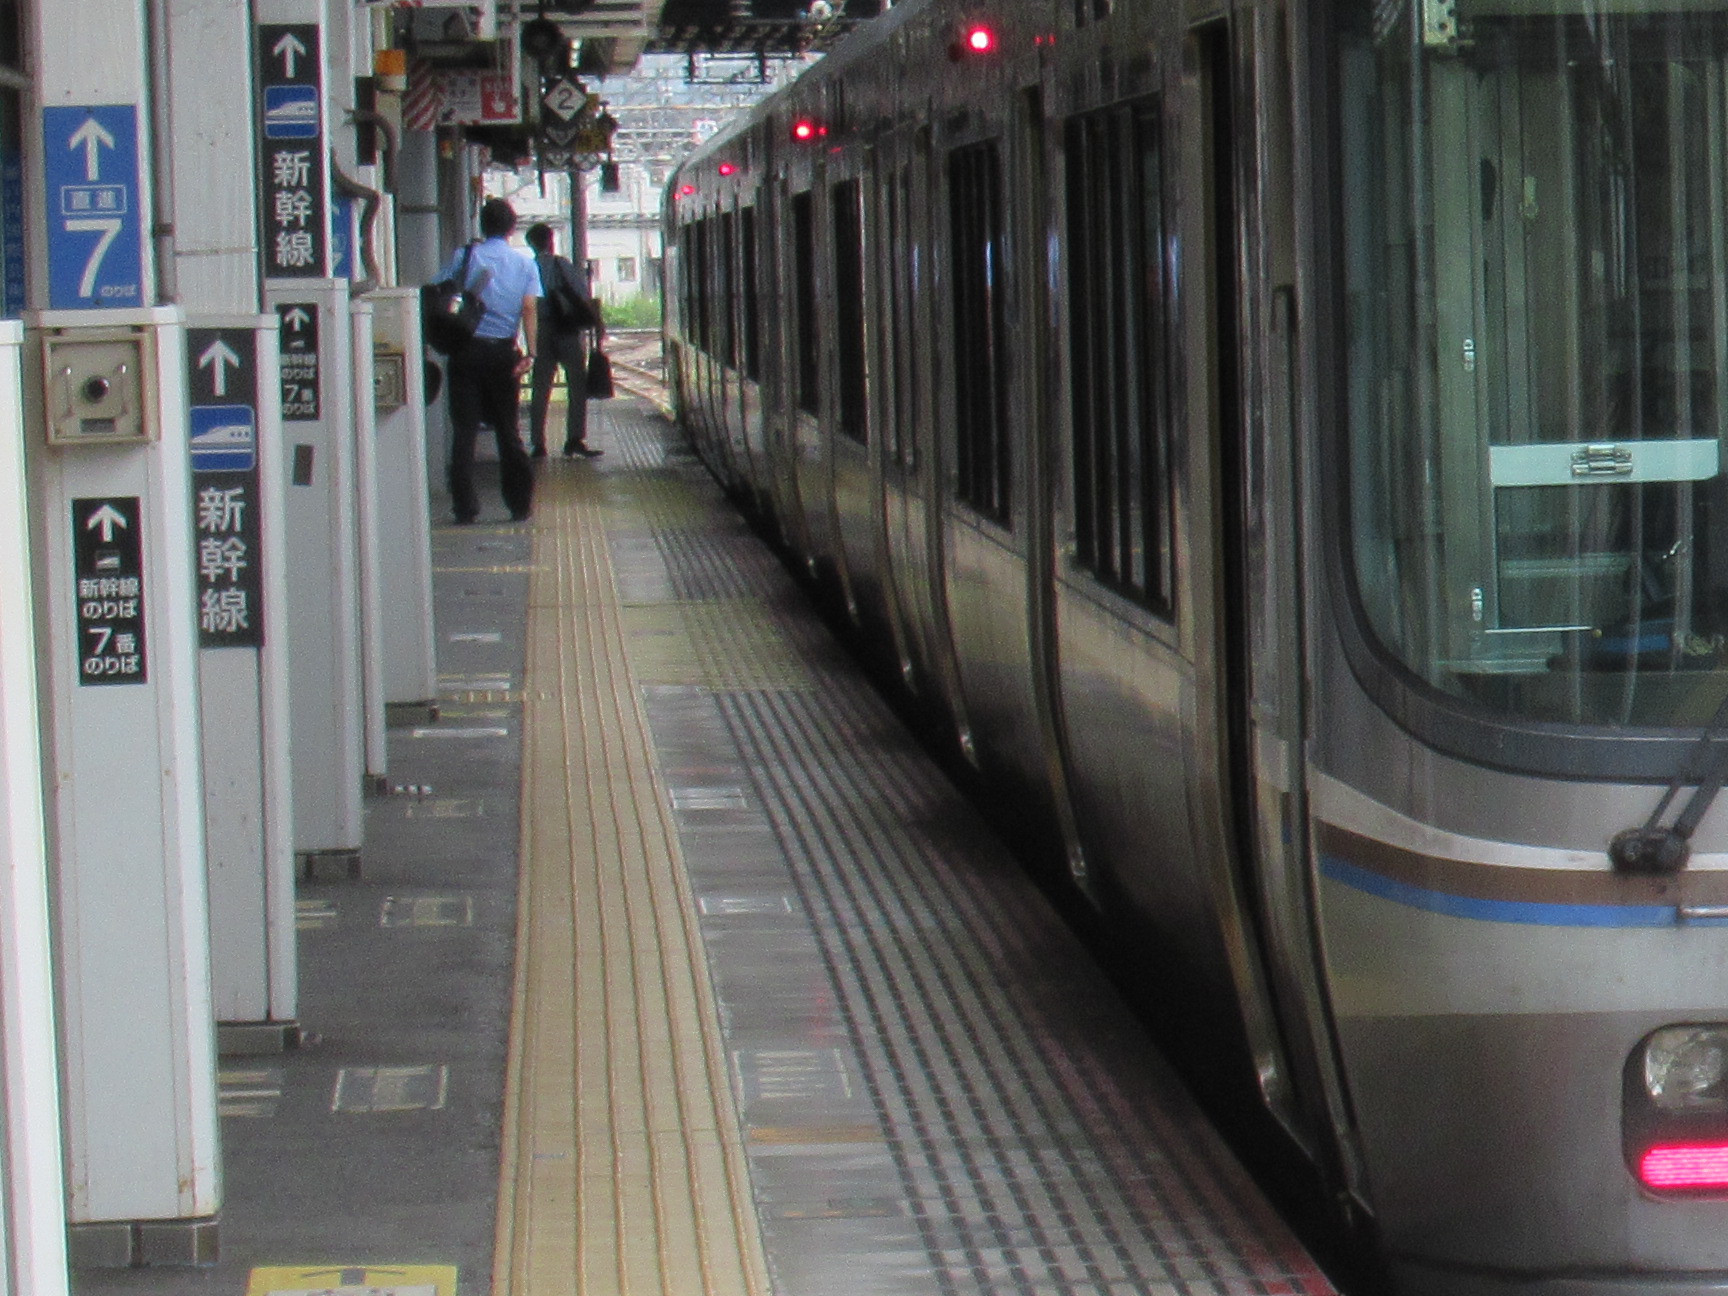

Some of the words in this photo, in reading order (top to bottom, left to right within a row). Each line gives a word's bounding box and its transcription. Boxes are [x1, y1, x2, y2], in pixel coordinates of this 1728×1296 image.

[558, 89, 574, 111] 2
[273, 151, 314, 267] 新幹線
[65, 219, 122, 298] 7
[101, 284, 137, 297] のりば
[199, 487, 249, 633] 新幹線
[79, 577, 140, 598] 新幹線
[83, 600, 137, 620] のりば
[87, 626, 136, 655] 7番
[84, 655, 139, 675] のりば
